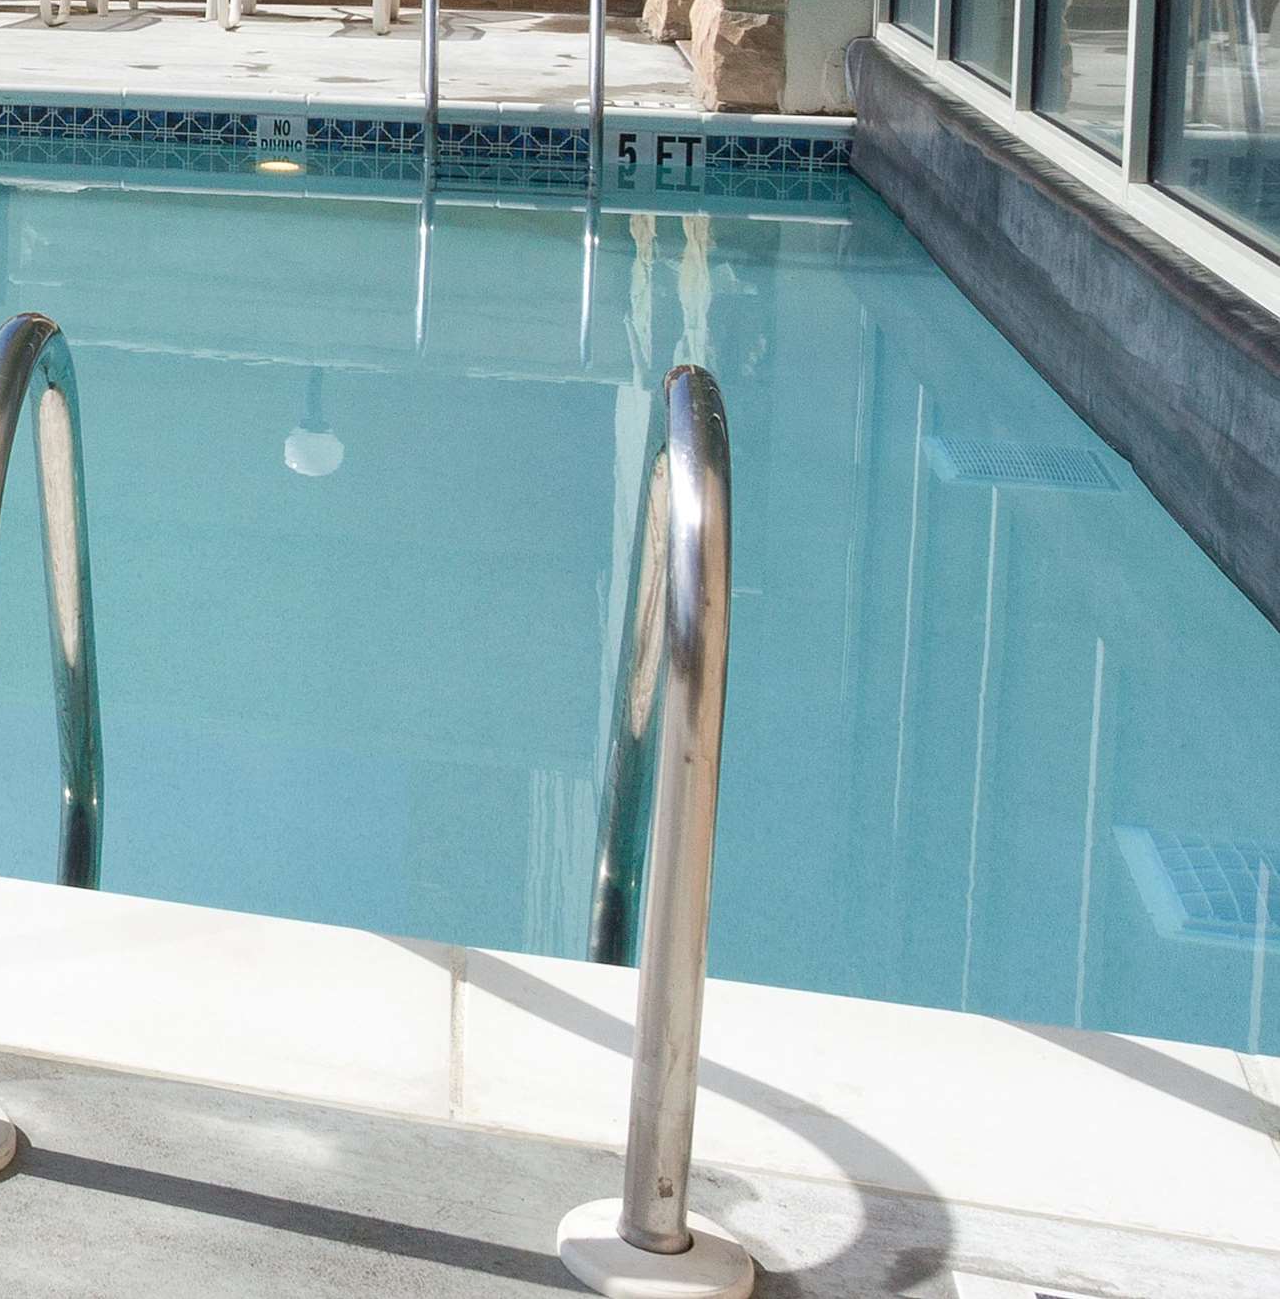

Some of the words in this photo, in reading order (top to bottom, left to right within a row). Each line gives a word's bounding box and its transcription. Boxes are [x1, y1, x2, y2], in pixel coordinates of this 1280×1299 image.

[273, 119, 291, 136] NO
[618, 133, 637, 164] 5
[656, 135, 702, 166] FT
